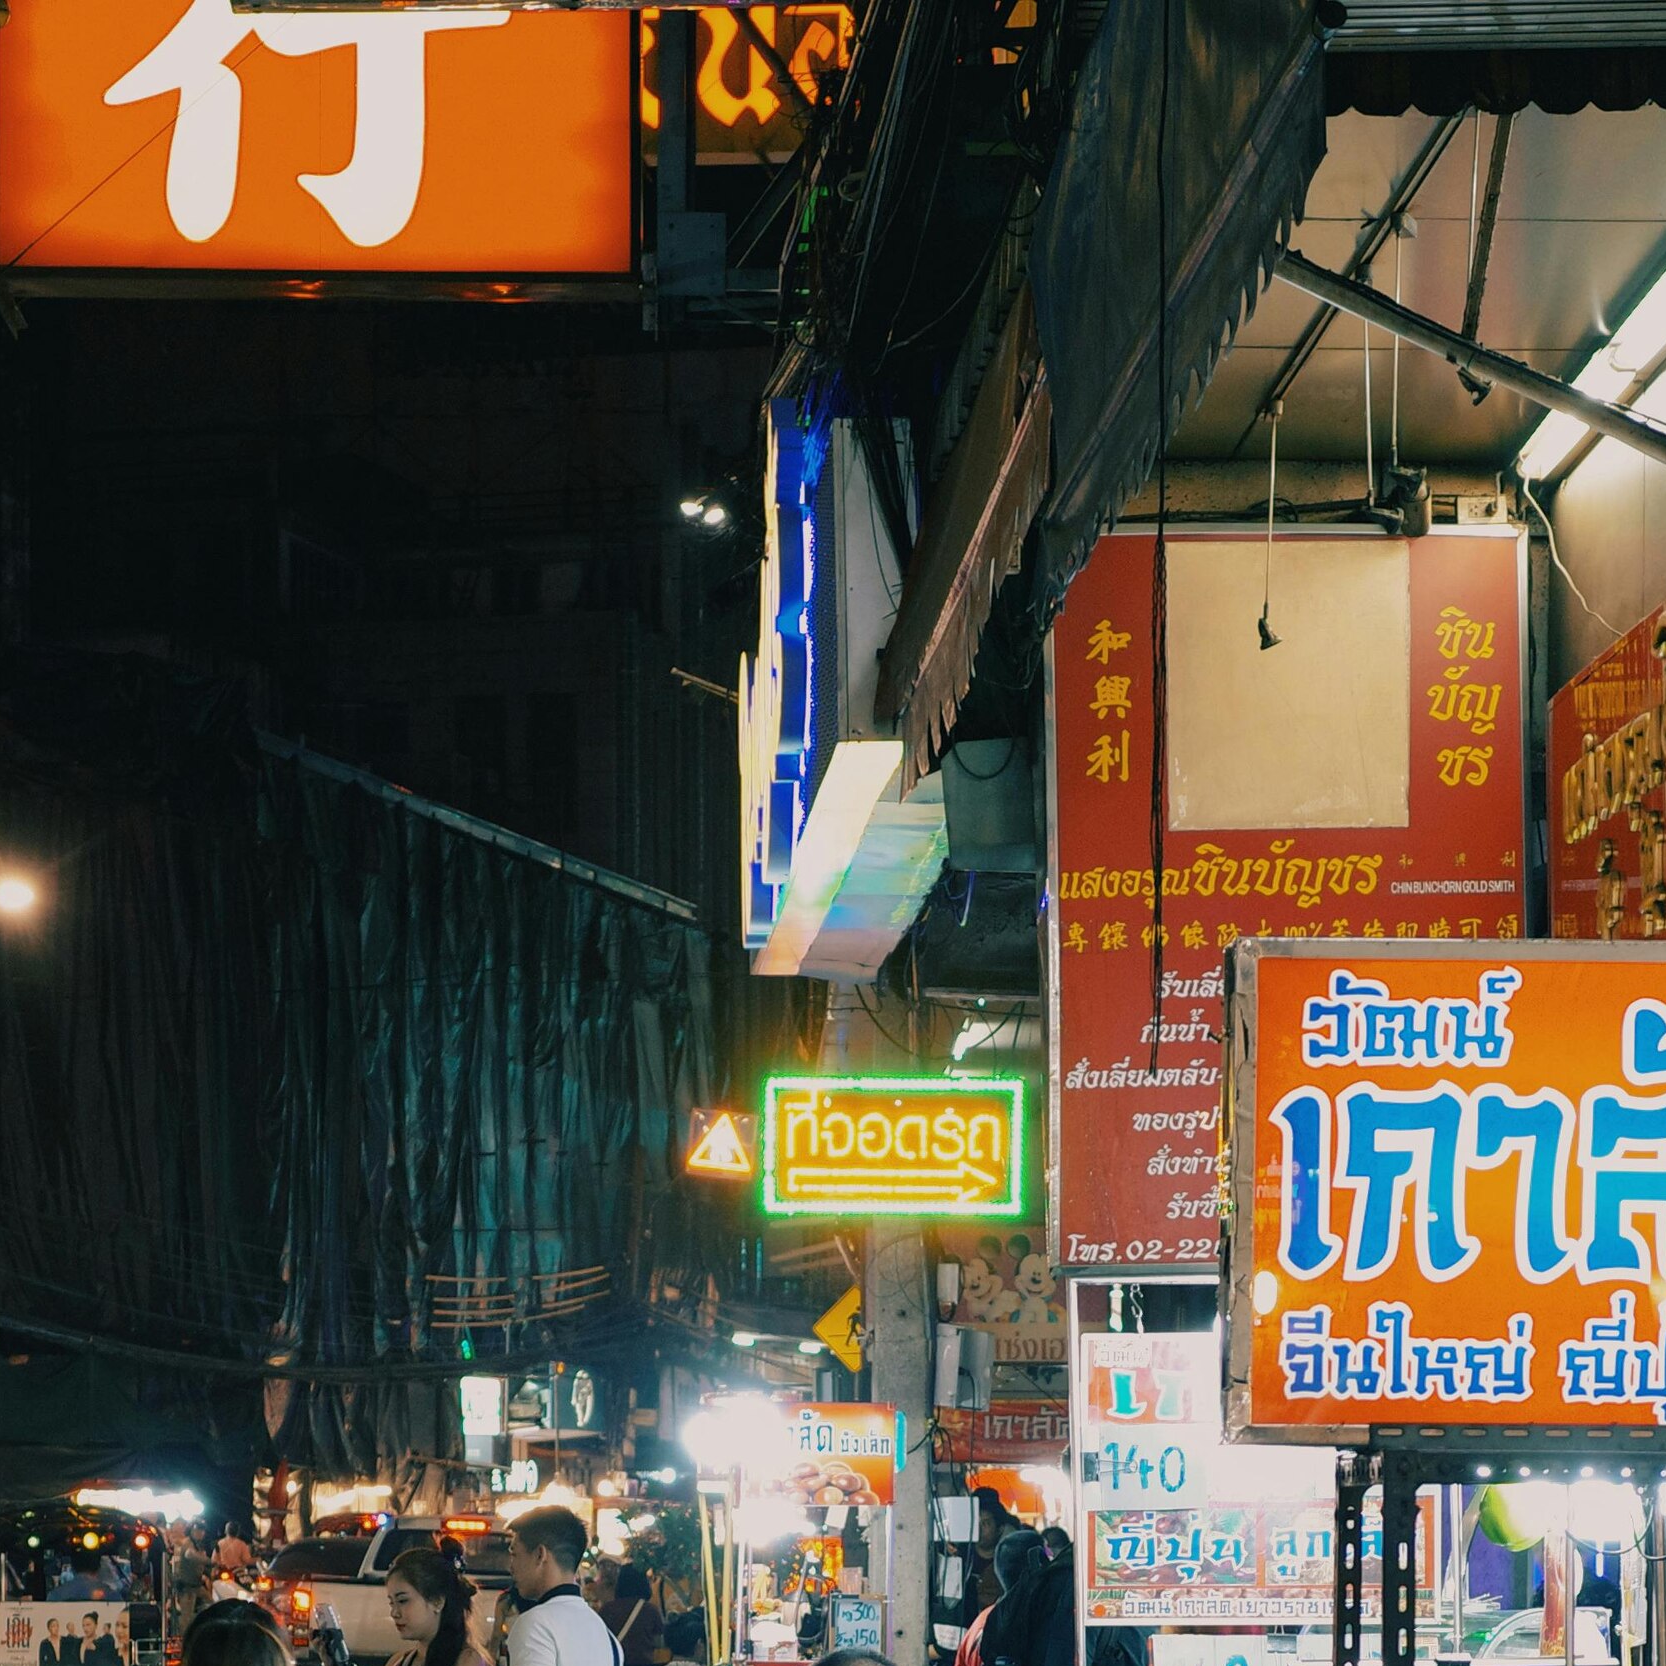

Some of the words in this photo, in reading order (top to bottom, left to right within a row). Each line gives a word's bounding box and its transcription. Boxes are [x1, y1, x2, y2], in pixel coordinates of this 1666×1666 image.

[1435, 606, 1495, 660] ชิน
[1085, 619, 1132, 784] 和興利
[1427, 667, 1501, 734] บัญ
[1437, 745, 1494, 787] ชร
[1391, 880, 1413, 894] CHIN
[1413, 880, 1462, 894] BUNCHORN
[1463, 880, 1487, 893] GOLD
[1488, 880, 1515, 893] SMITH
[1302, 966, 1522, 1067] วัฒน์
[786, 1085, 1002, 1162] ที่จอดรถ
[1282, 1300, 1533, 1404] จีนใหญ่
[1104, 1442, 1186, 1493] 140
[1106, 1511, 1247, 1584] ญี่ปุ่น
